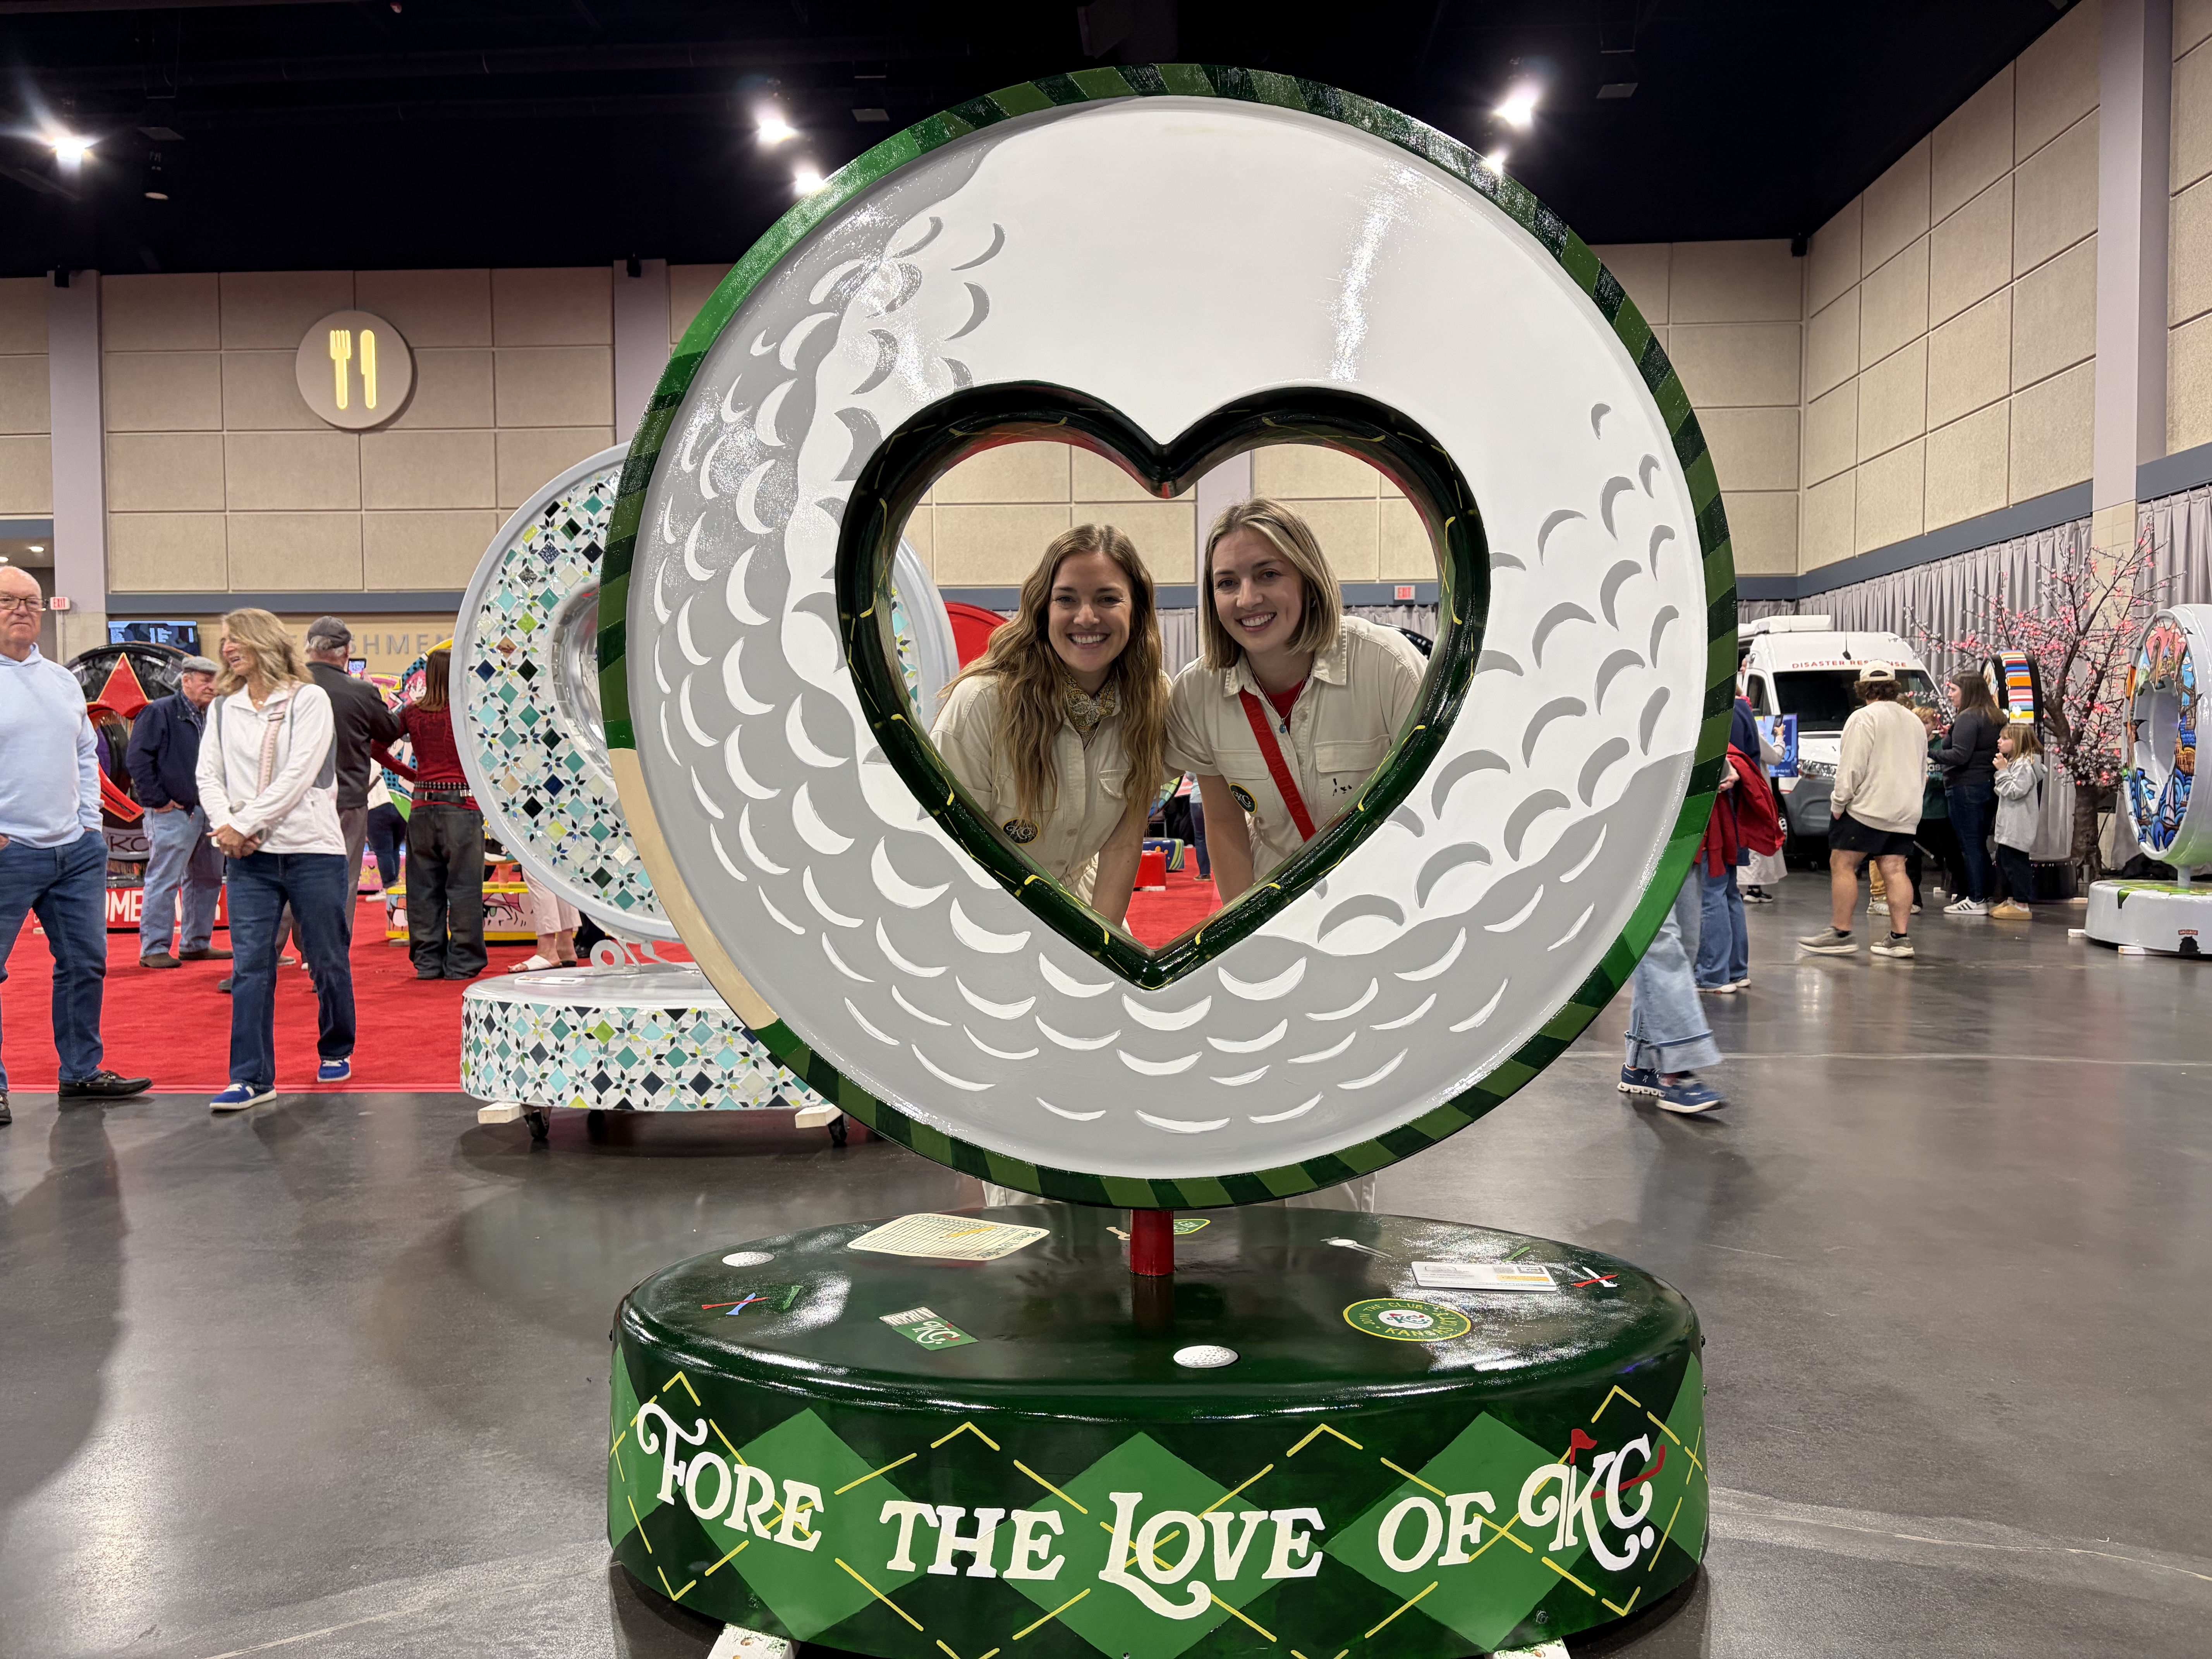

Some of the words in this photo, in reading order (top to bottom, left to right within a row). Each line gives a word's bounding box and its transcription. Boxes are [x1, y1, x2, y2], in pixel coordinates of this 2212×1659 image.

[1397, 586, 1412, 598] EXIT
[53, 598, 65, 608] EXIT
[1792, 660, 1845, 669] DISASTER
[1358, 1313, 1376, 1325] JOIN
[636, 1402, 824, 1552] FORE
[879, 1500, 1065, 1580] THE
[1098, 1491, 1325, 1620] LOVE
[1377, 1491, 1497, 1573] OF
